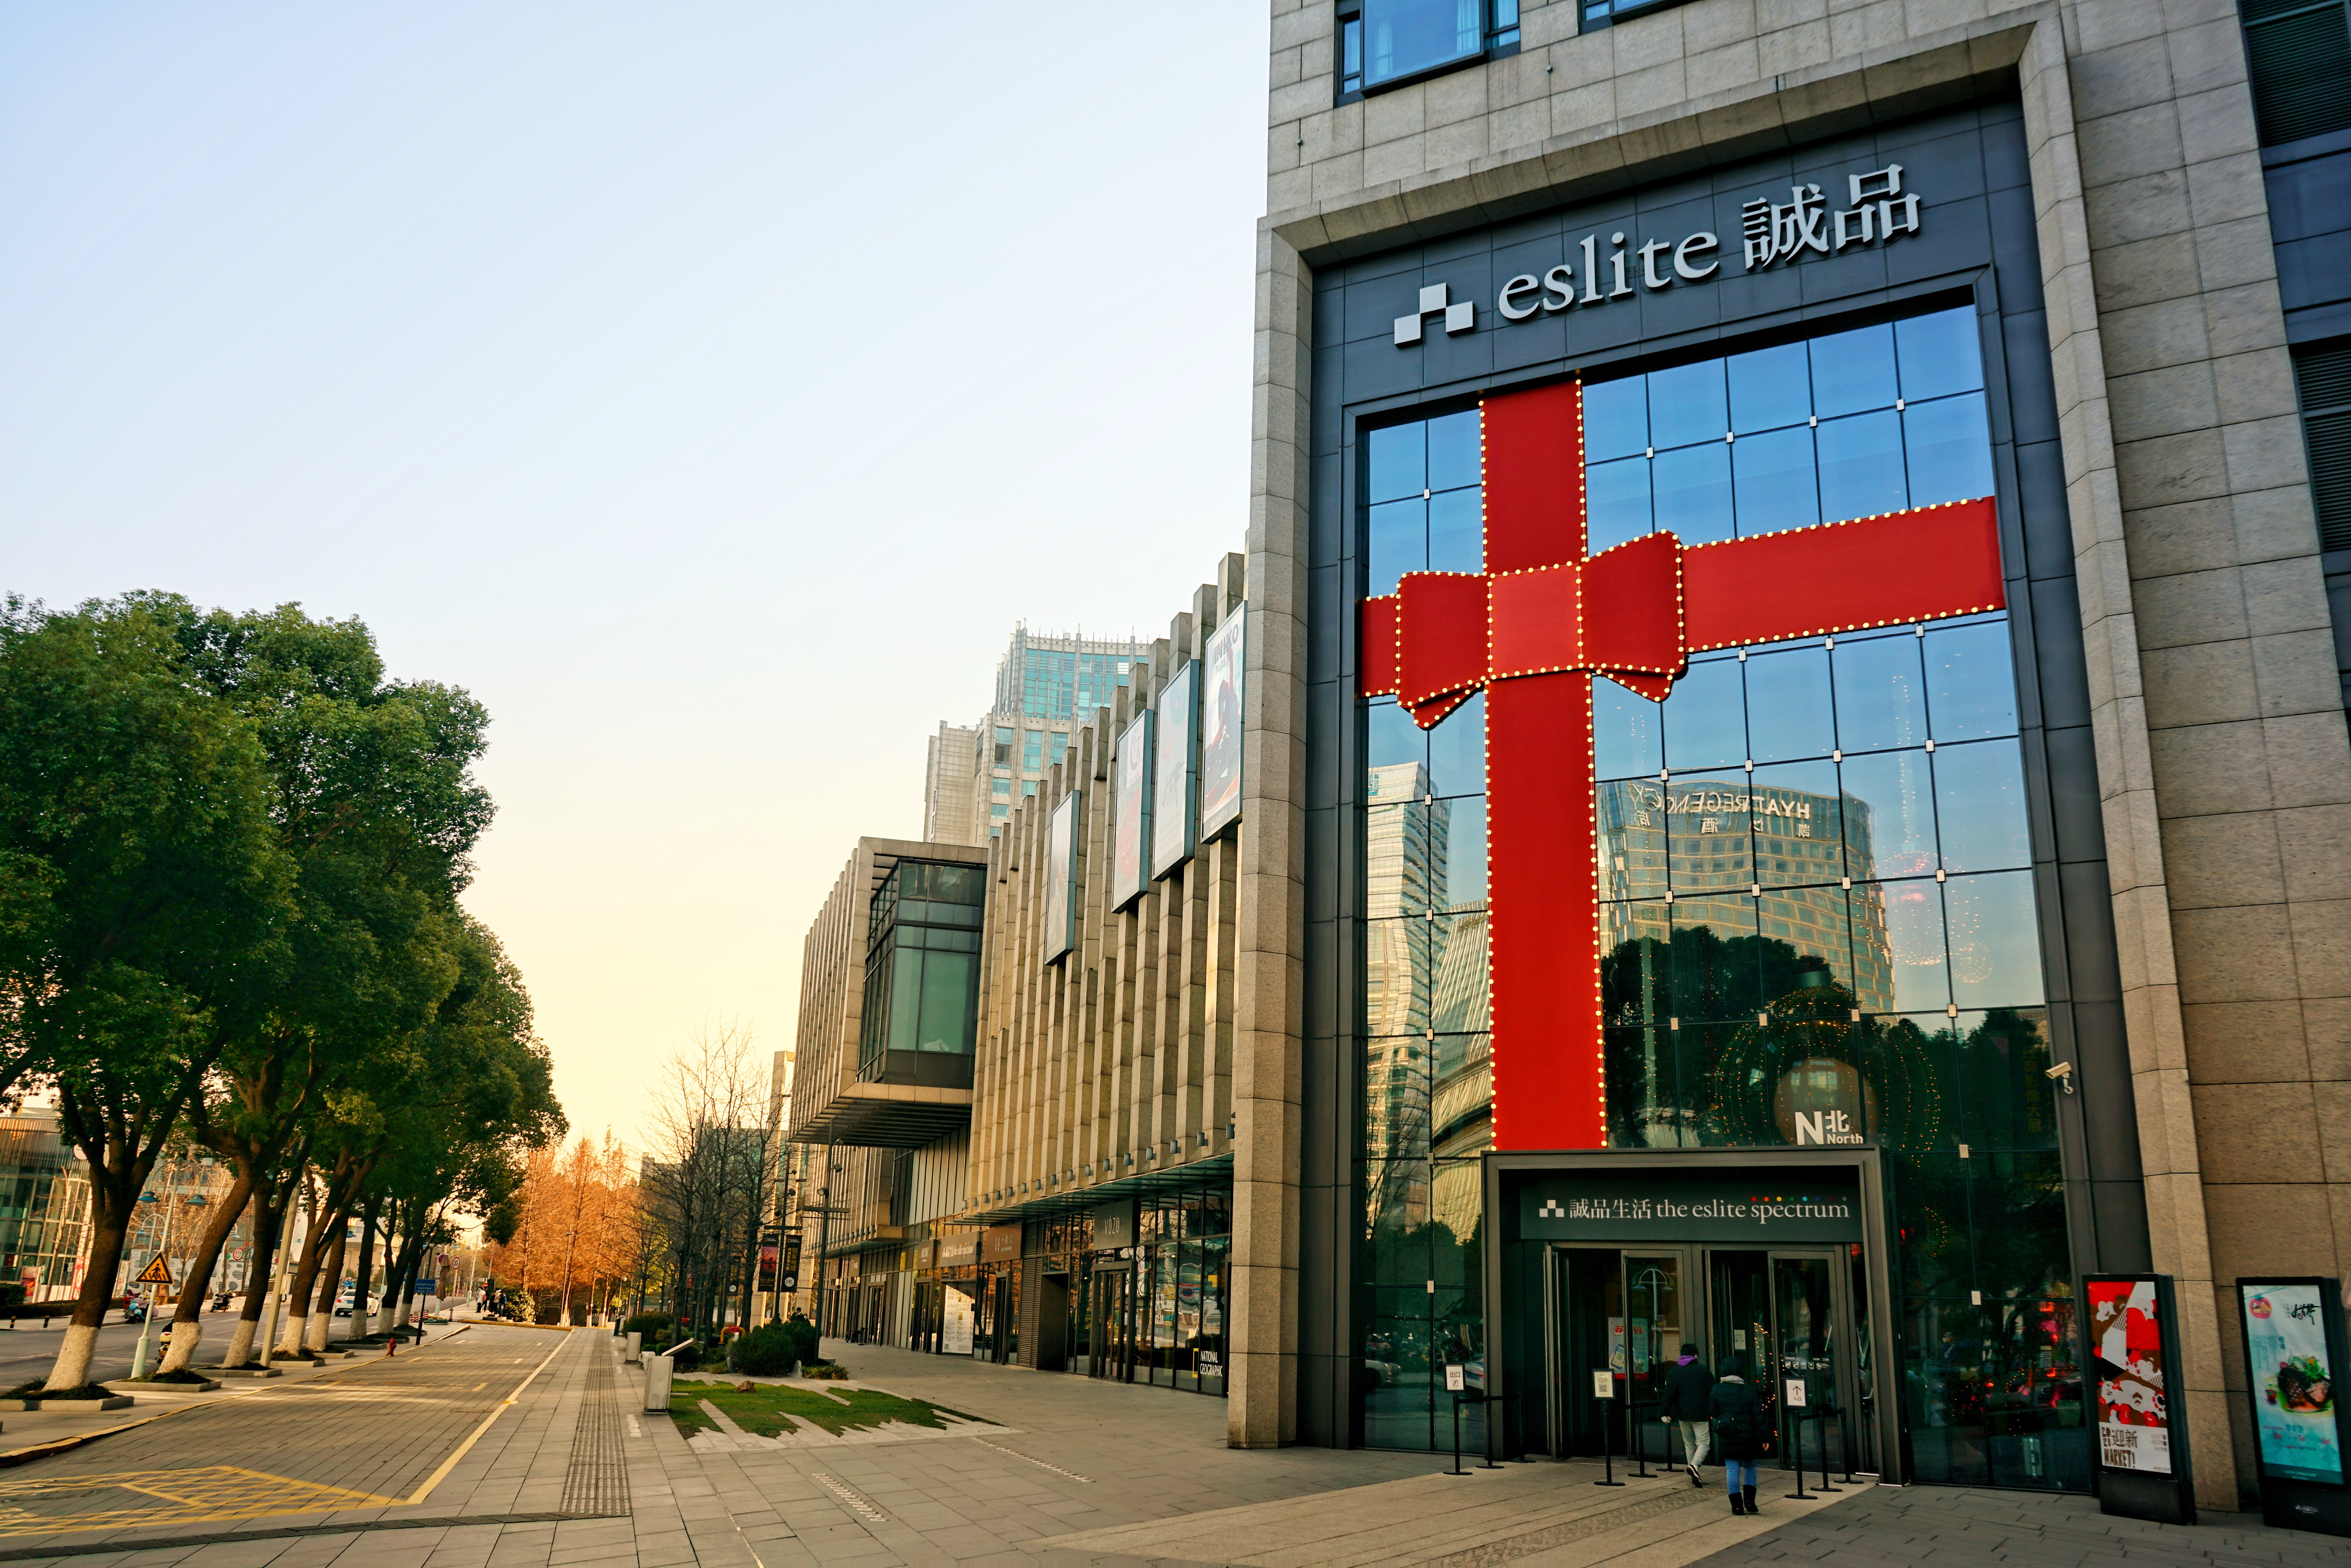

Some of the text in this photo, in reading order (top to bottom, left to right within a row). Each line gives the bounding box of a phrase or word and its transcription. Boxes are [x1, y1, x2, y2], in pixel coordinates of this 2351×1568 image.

[1498, 164, 1921, 319] eslite 誠品
[1795, 1110, 1850, 1145] N 北
[1826, 1133, 1863, 1145] North
[1570, 1198, 1850, 1224] 誠品生活 the eslite spectrum
[1200, 1350, 1218, 1363] NATIONAL
[1200, 1363, 1223, 1378] GEOGRAPHIC
[2111, 1430, 2138, 1449] 迎新
[2104, 1448, 2135, 1469] MARKET!
